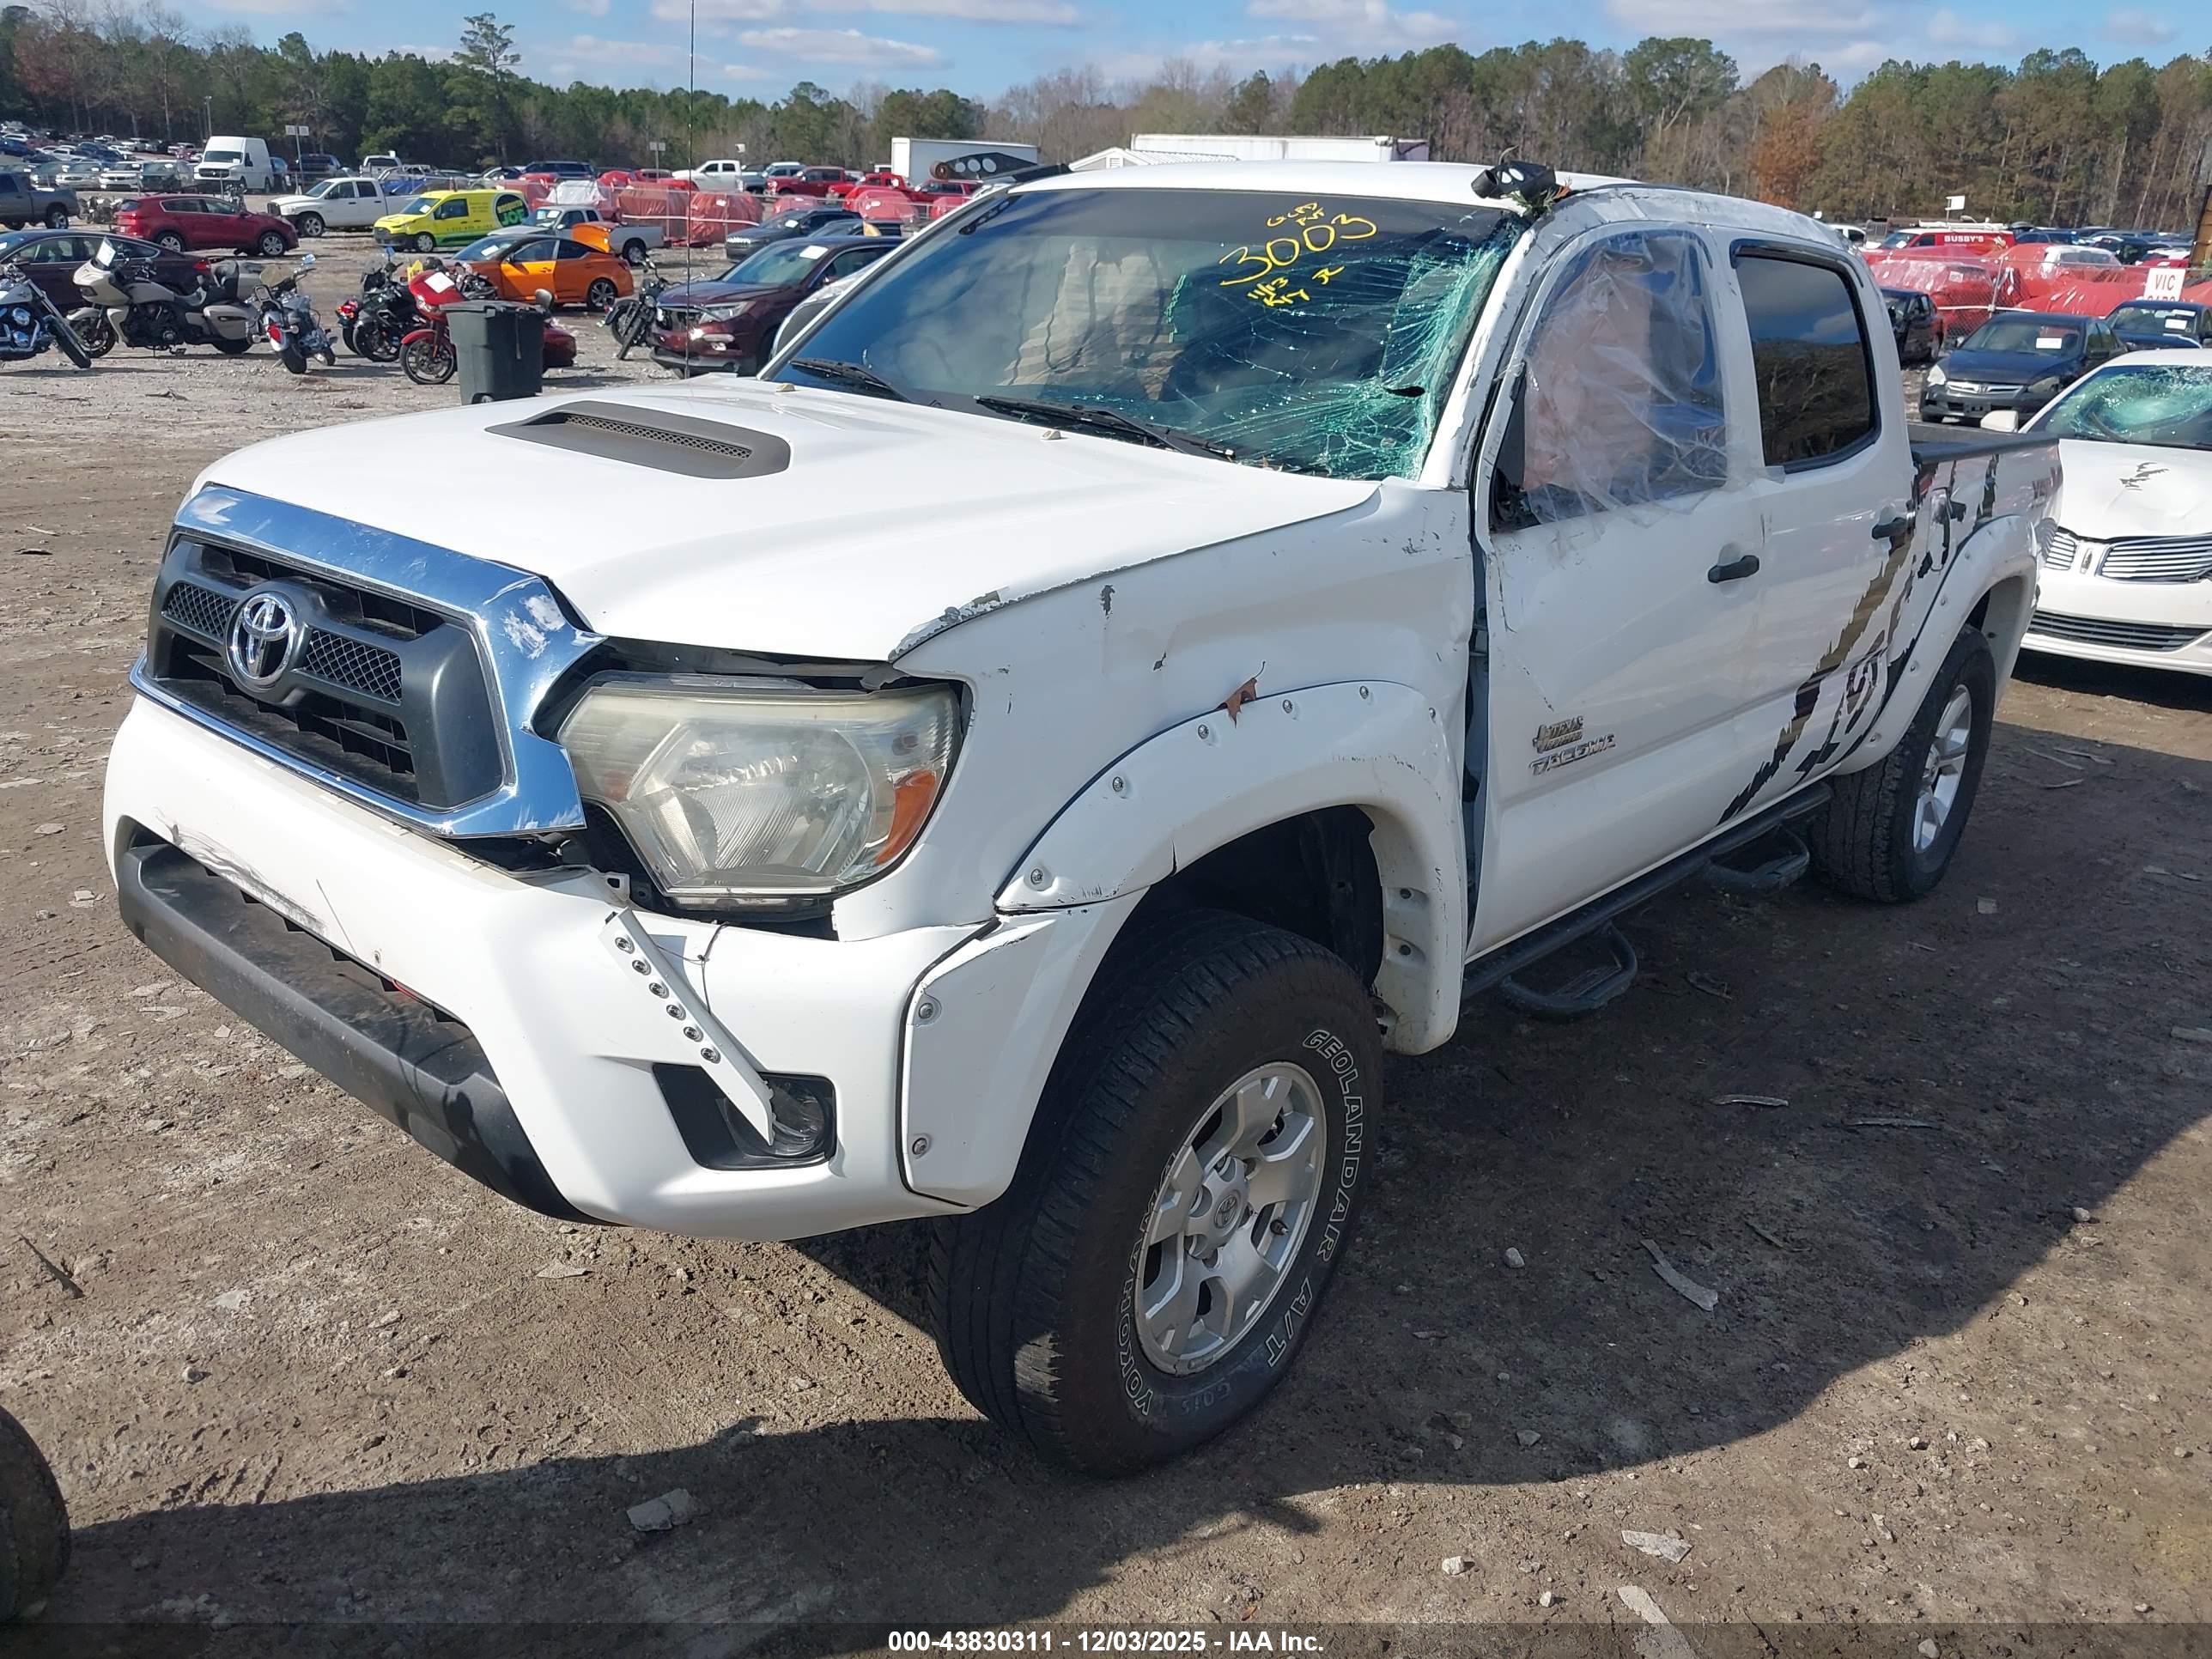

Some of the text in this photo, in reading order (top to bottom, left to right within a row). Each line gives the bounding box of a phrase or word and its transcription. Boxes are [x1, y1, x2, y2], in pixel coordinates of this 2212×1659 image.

[1219, 213, 1377, 286] 3003
[2155, 274, 2176, 291] VIC
[1266, 1030, 1364, 1368] GEOLANDAR A/T
